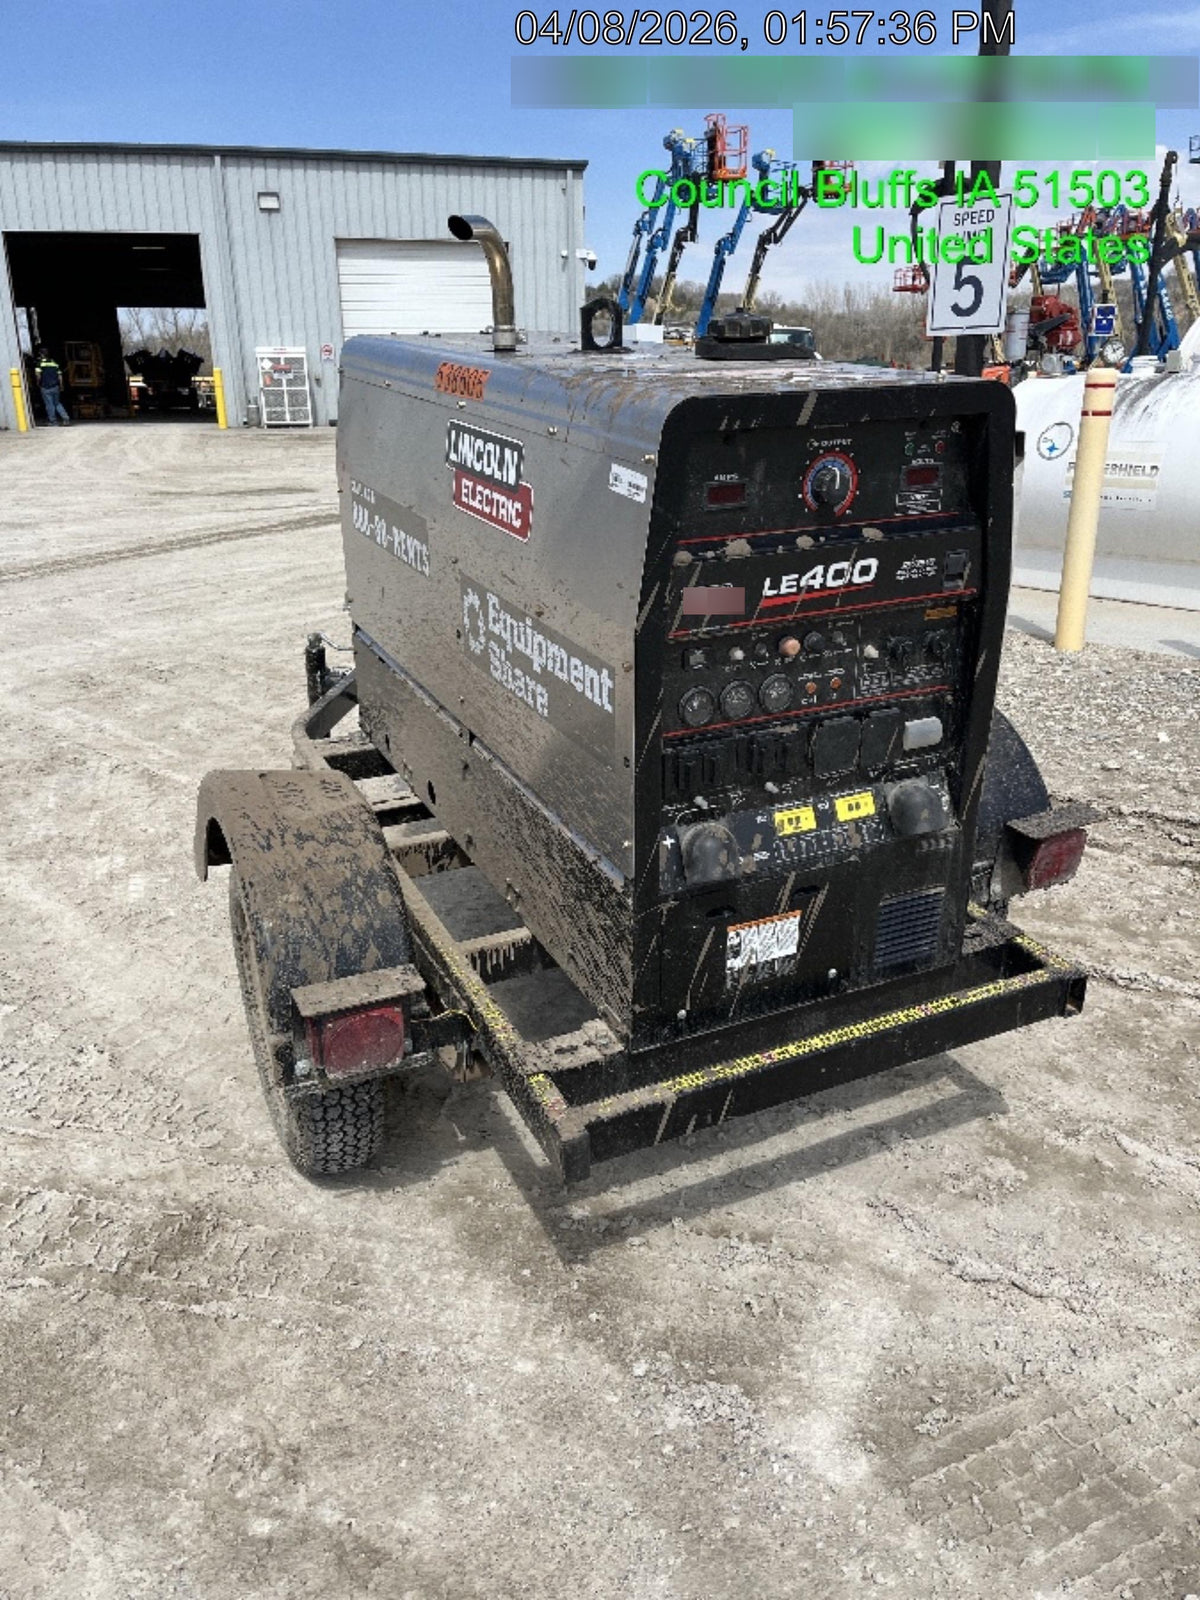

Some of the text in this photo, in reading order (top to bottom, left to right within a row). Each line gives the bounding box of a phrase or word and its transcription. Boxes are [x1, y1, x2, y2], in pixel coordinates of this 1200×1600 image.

[953, 209, 995, 227] SPEED
[950, 255, 984, 317] 5
[449, 429, 518, 487] LINCOLN
[461, 477, 522, 529] ELECTRIC
[762, 556, 880, 598] LE400
[486, 591, 615, 715] Equipment
[487, 639, 549, 718] Share
